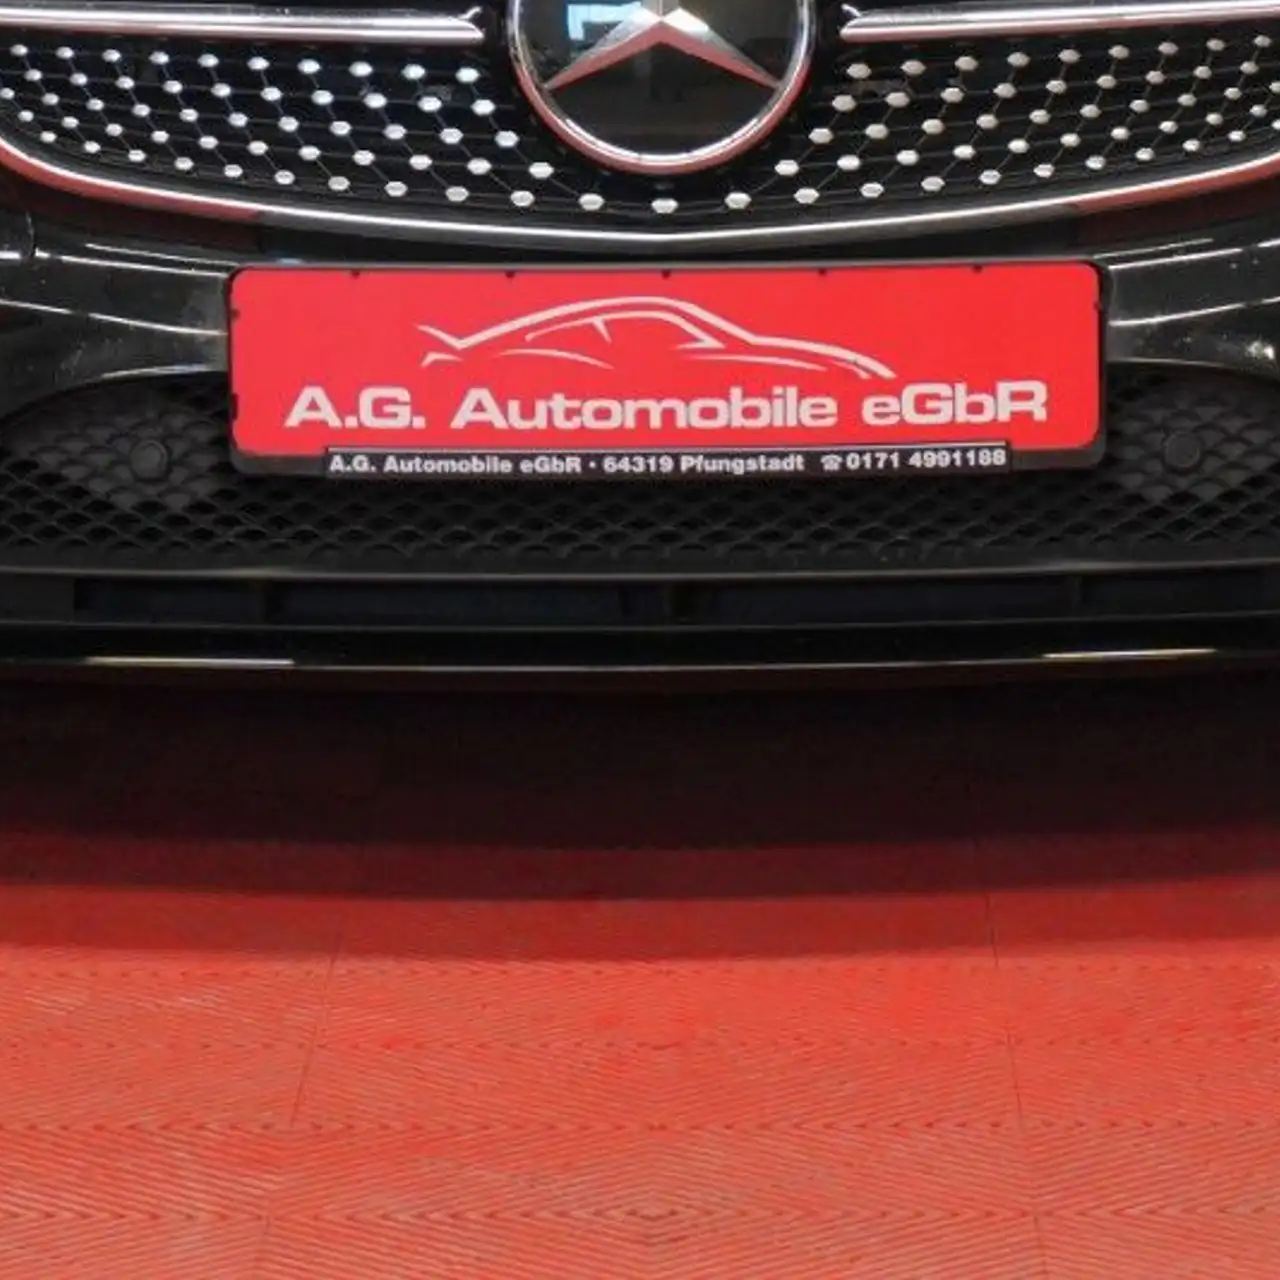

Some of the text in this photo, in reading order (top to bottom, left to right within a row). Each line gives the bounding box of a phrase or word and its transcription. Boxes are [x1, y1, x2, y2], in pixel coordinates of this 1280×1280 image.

[284, 380, 1047, 429] A.G. Automobile eGbR
[329, 456, 376, 472] A.G.
[383, 456, 512, 473] Automobile
[520, 456, 582, 473] eGbR
[602, 456, 673, 472] 64319
[680, 455, 805, 475] Pfungstadt
[846, 451, 900, 470] 0171
